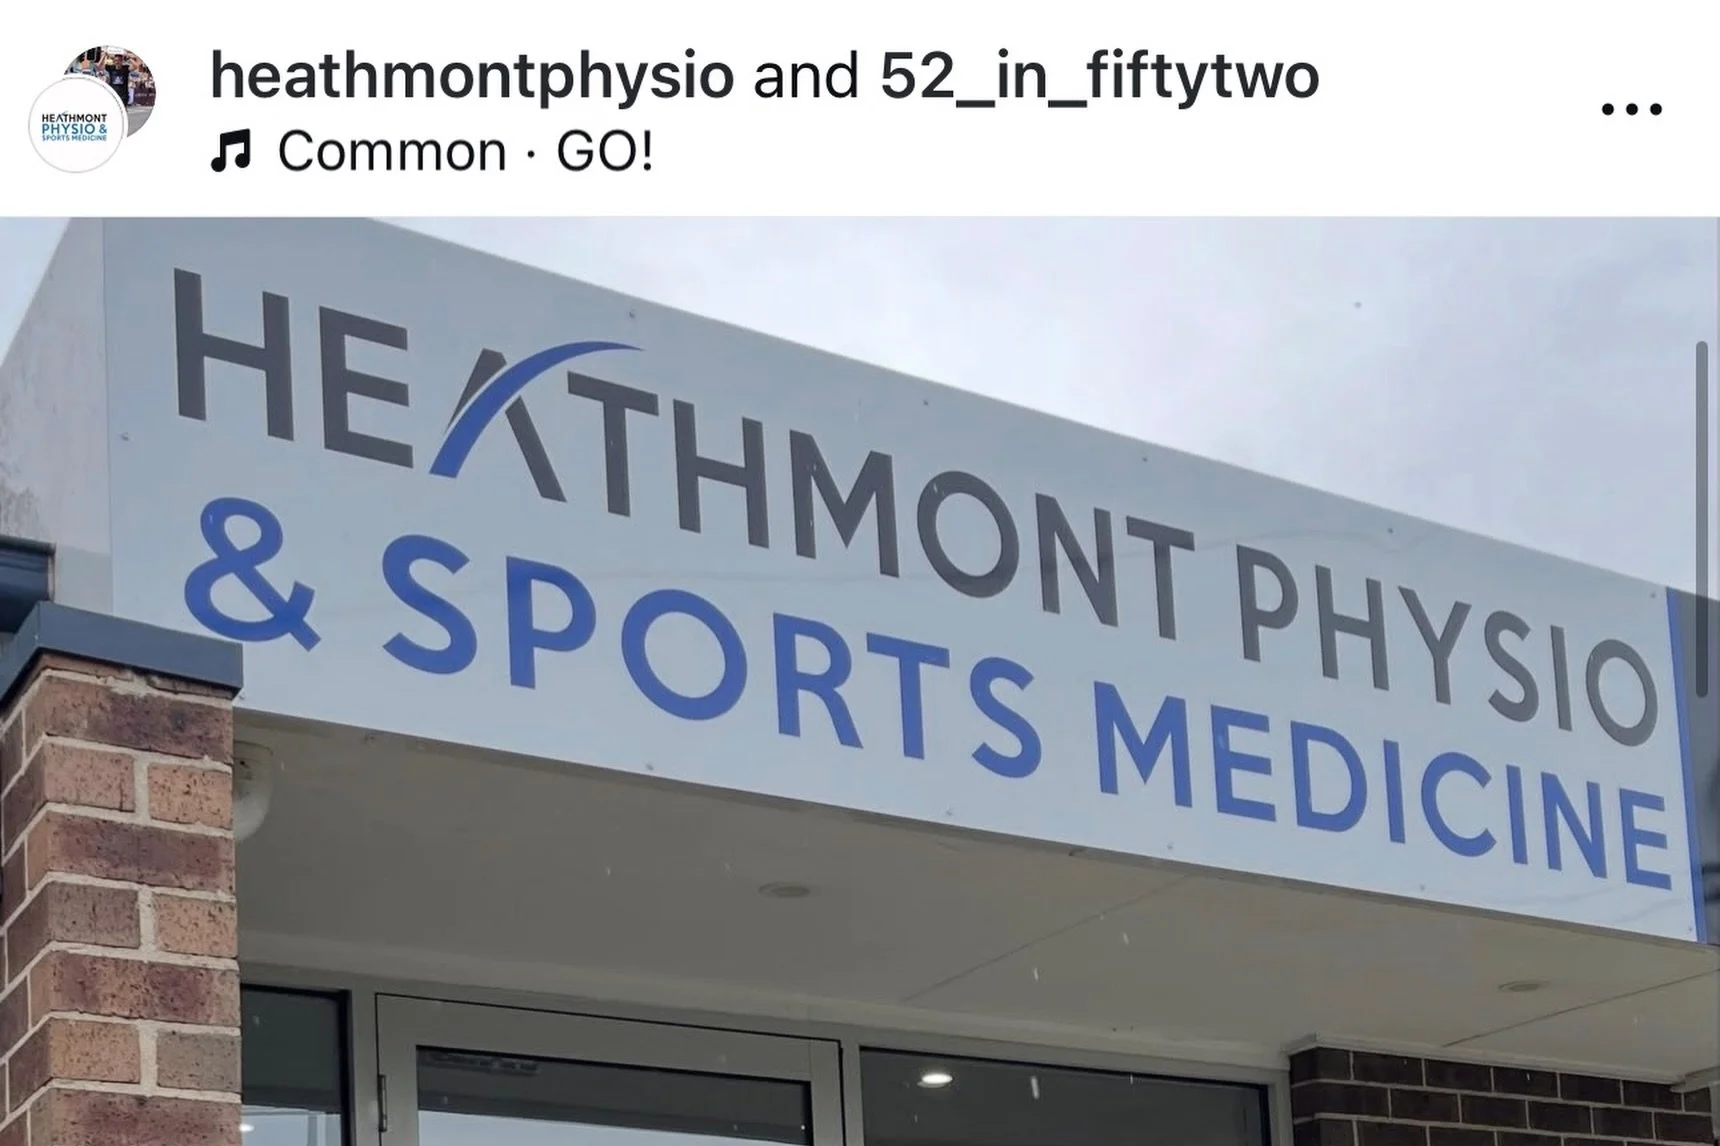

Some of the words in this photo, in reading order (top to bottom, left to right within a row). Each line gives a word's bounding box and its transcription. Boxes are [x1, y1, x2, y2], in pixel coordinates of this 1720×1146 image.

[174, 267, 1195, 640] HEATHMONT
[1237, 544, 1658, 747] PHYSIO
[184, 497, 321, 651] &
[382, 533, 1041, 779] SPORTS
[1094, 680, 1672, 891] MEDICINE
